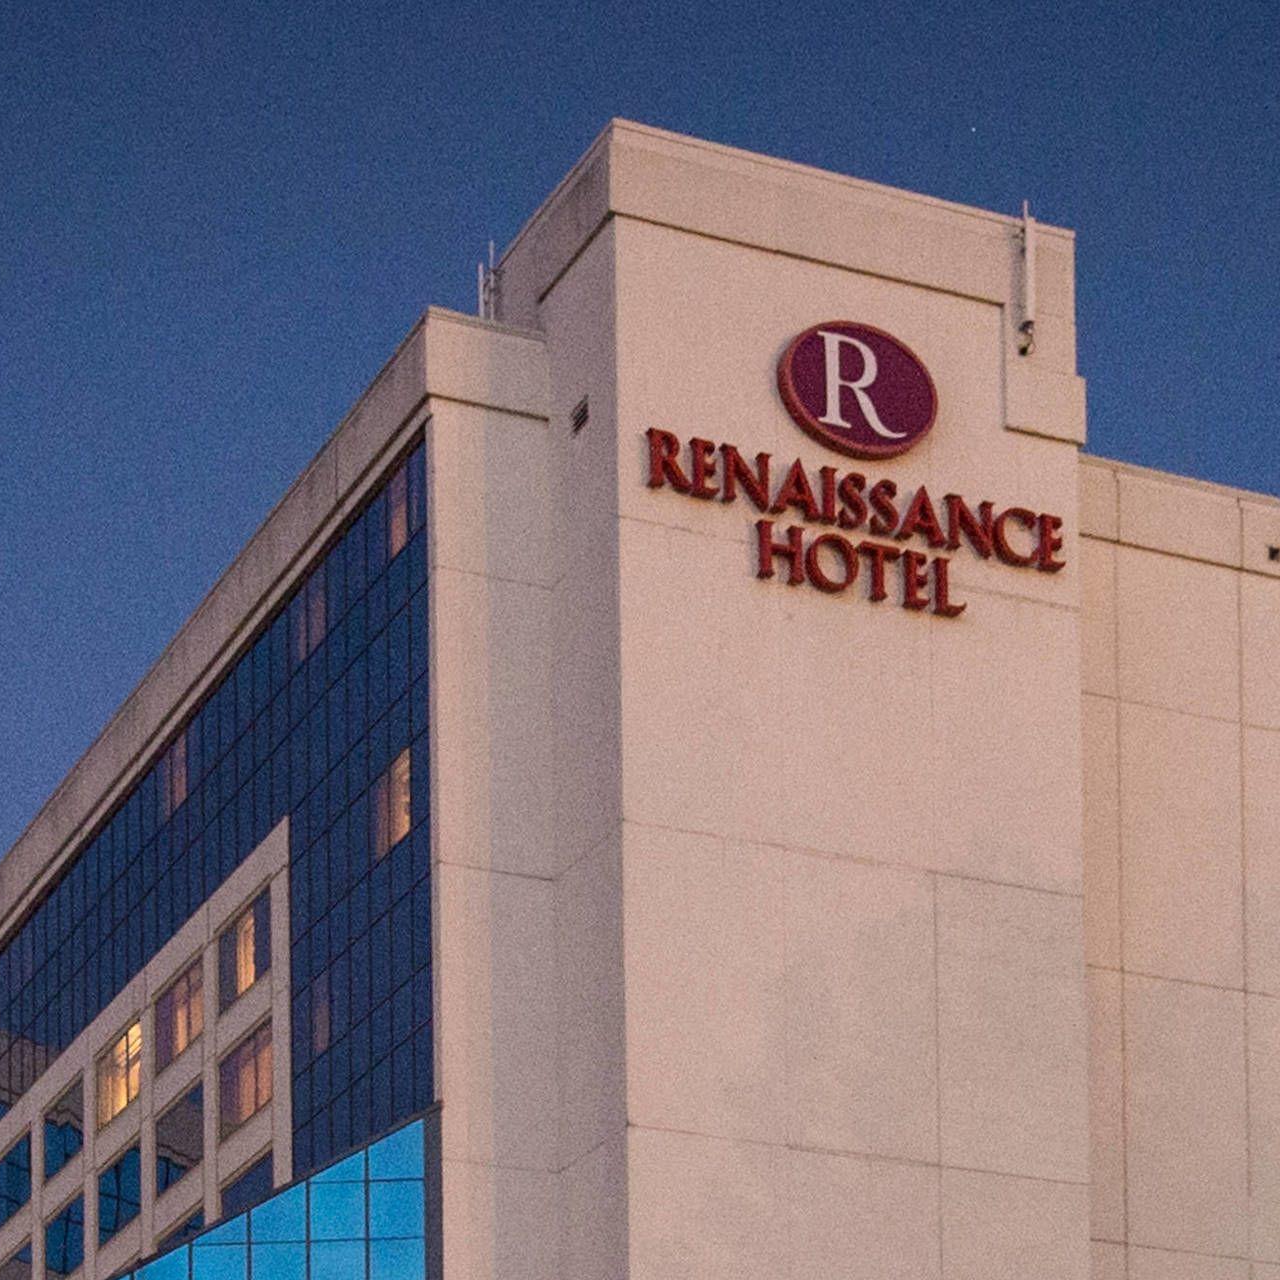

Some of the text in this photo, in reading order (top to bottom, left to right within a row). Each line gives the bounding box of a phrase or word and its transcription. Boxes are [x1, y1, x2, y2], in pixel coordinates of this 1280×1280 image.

[818, 331, 907, 438] R
[646, 428, 1065, 572] RENAISSANCE
[755, 520, 967, 617] HOTEL
